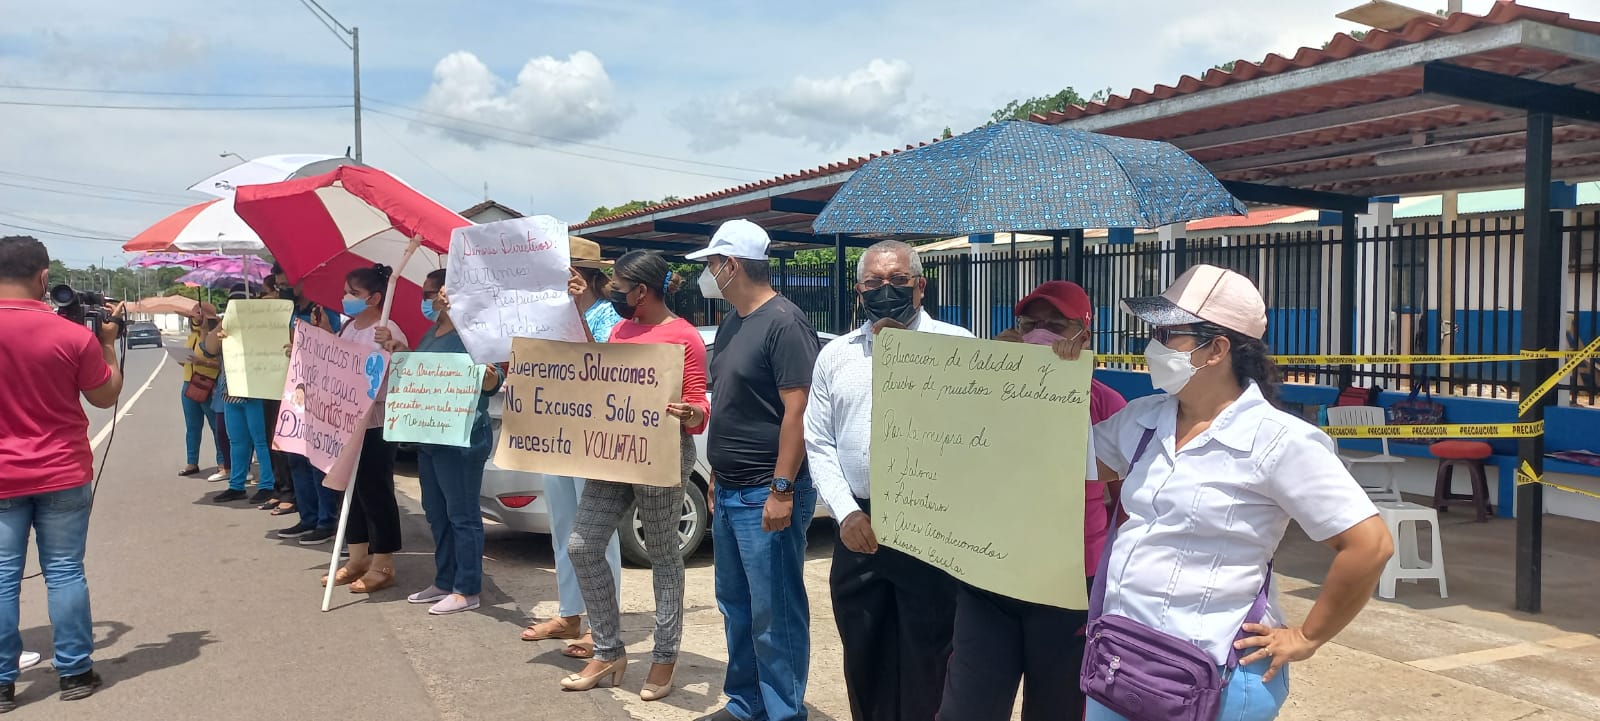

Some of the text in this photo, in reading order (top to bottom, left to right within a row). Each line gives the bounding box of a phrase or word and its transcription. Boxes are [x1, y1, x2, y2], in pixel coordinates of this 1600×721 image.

[508, 351, 659, 388] Queremos Soluciones,
[943, 347, 961, 372] de
[968, 349, 1024, 372] Calidad
[1038, 363, 1057, 386] y
[921, 375, 937, 397] de
[937, 382, 993, 400] nuestros
[403, 413, 417, 427] No
[504, 385, 522, 414] No
[641, 409, 660, 427] se
[509, 427, 571, 455] necesita
[969, 427, 991, 449] de
